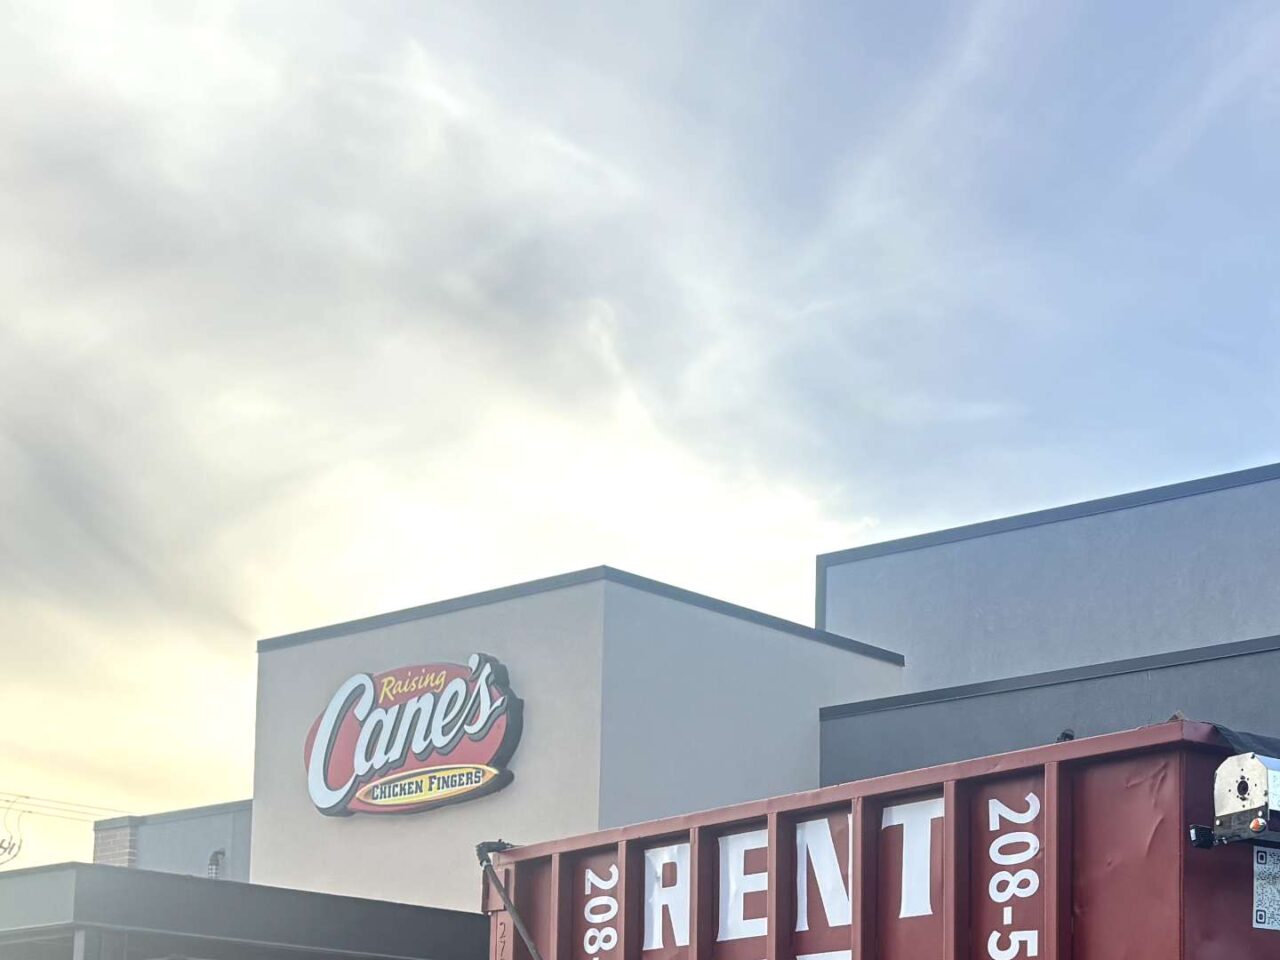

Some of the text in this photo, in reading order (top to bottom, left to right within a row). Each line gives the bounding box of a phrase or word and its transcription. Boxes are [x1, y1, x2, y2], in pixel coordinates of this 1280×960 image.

[308, 654, 505, 808] Cane's
[379, 669, 446, 703] Raising
[372, 771, 481, 800] CHICKEN FINGERS
[643, 798, 944, 950] RENT
